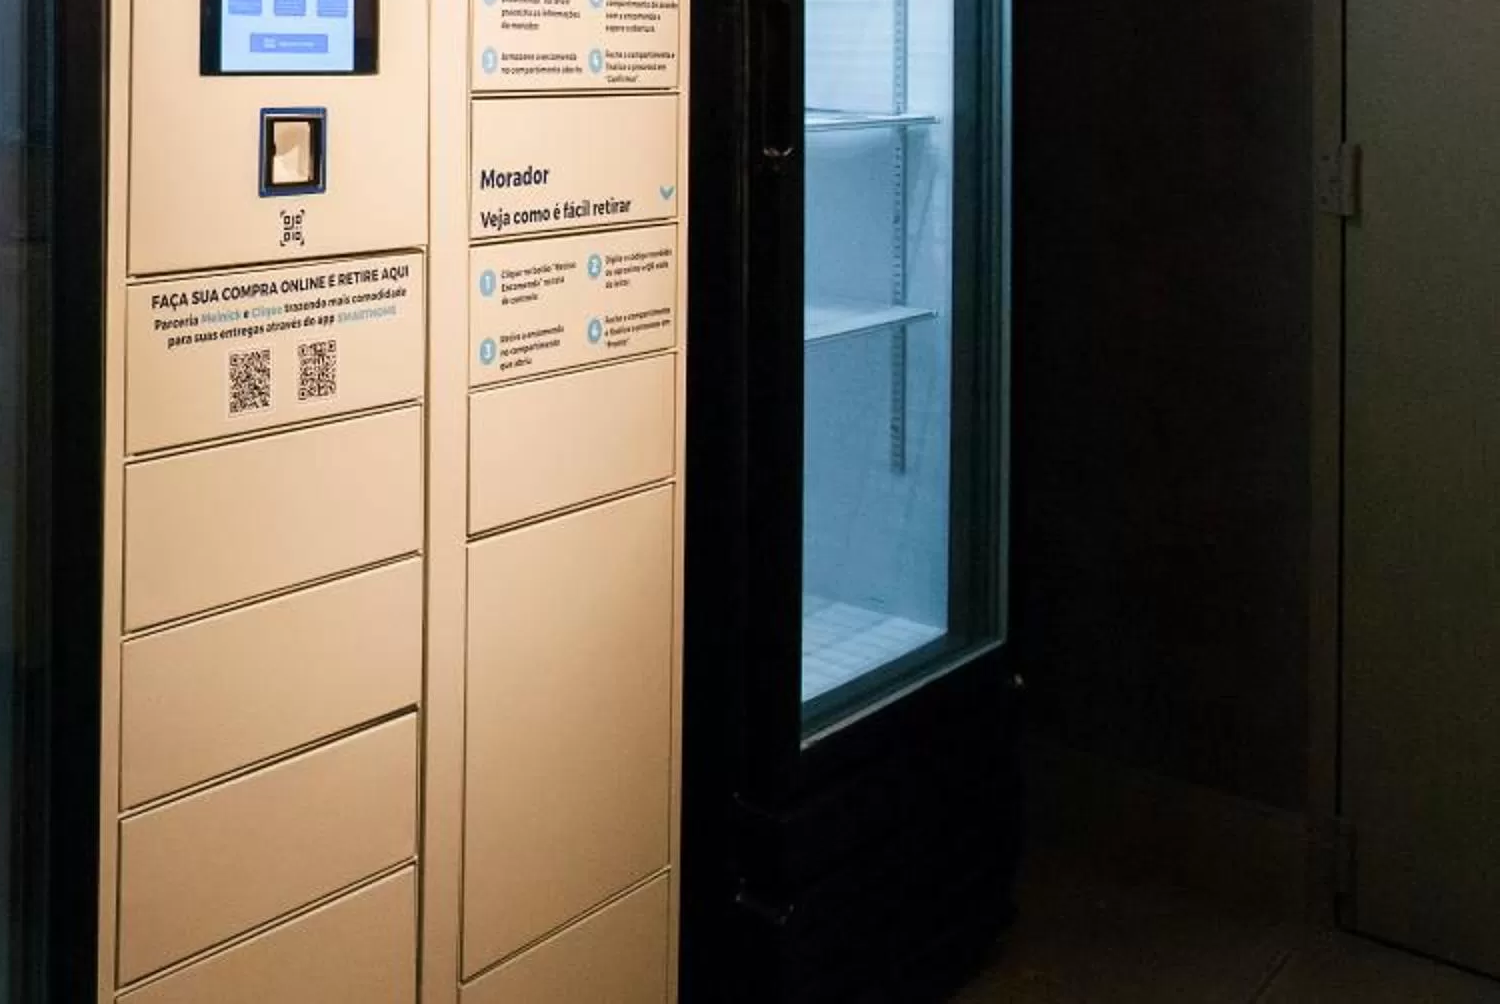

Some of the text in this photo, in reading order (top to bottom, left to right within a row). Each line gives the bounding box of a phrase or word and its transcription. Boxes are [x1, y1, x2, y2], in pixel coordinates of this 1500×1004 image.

[480, 165, 549, 190] Morador
[481, 197, 631, 231] Veja como é fácil retirar
[151, 295, 189, 312] FAÇA
[191, 289, 219, 305] SUA
[221, 283, 279, 302] COMPRA
[281, 276, 326, 296] ONLINE
[338, 269, 379, 286] RETIRE
[381, 265, 409, 280] AQUI
[154, 315, 199, 331] Parceria
[167, 334, 192, 349] para
[194, 330, 218, 342] suas
[219, 323, 265, 340] entregas
